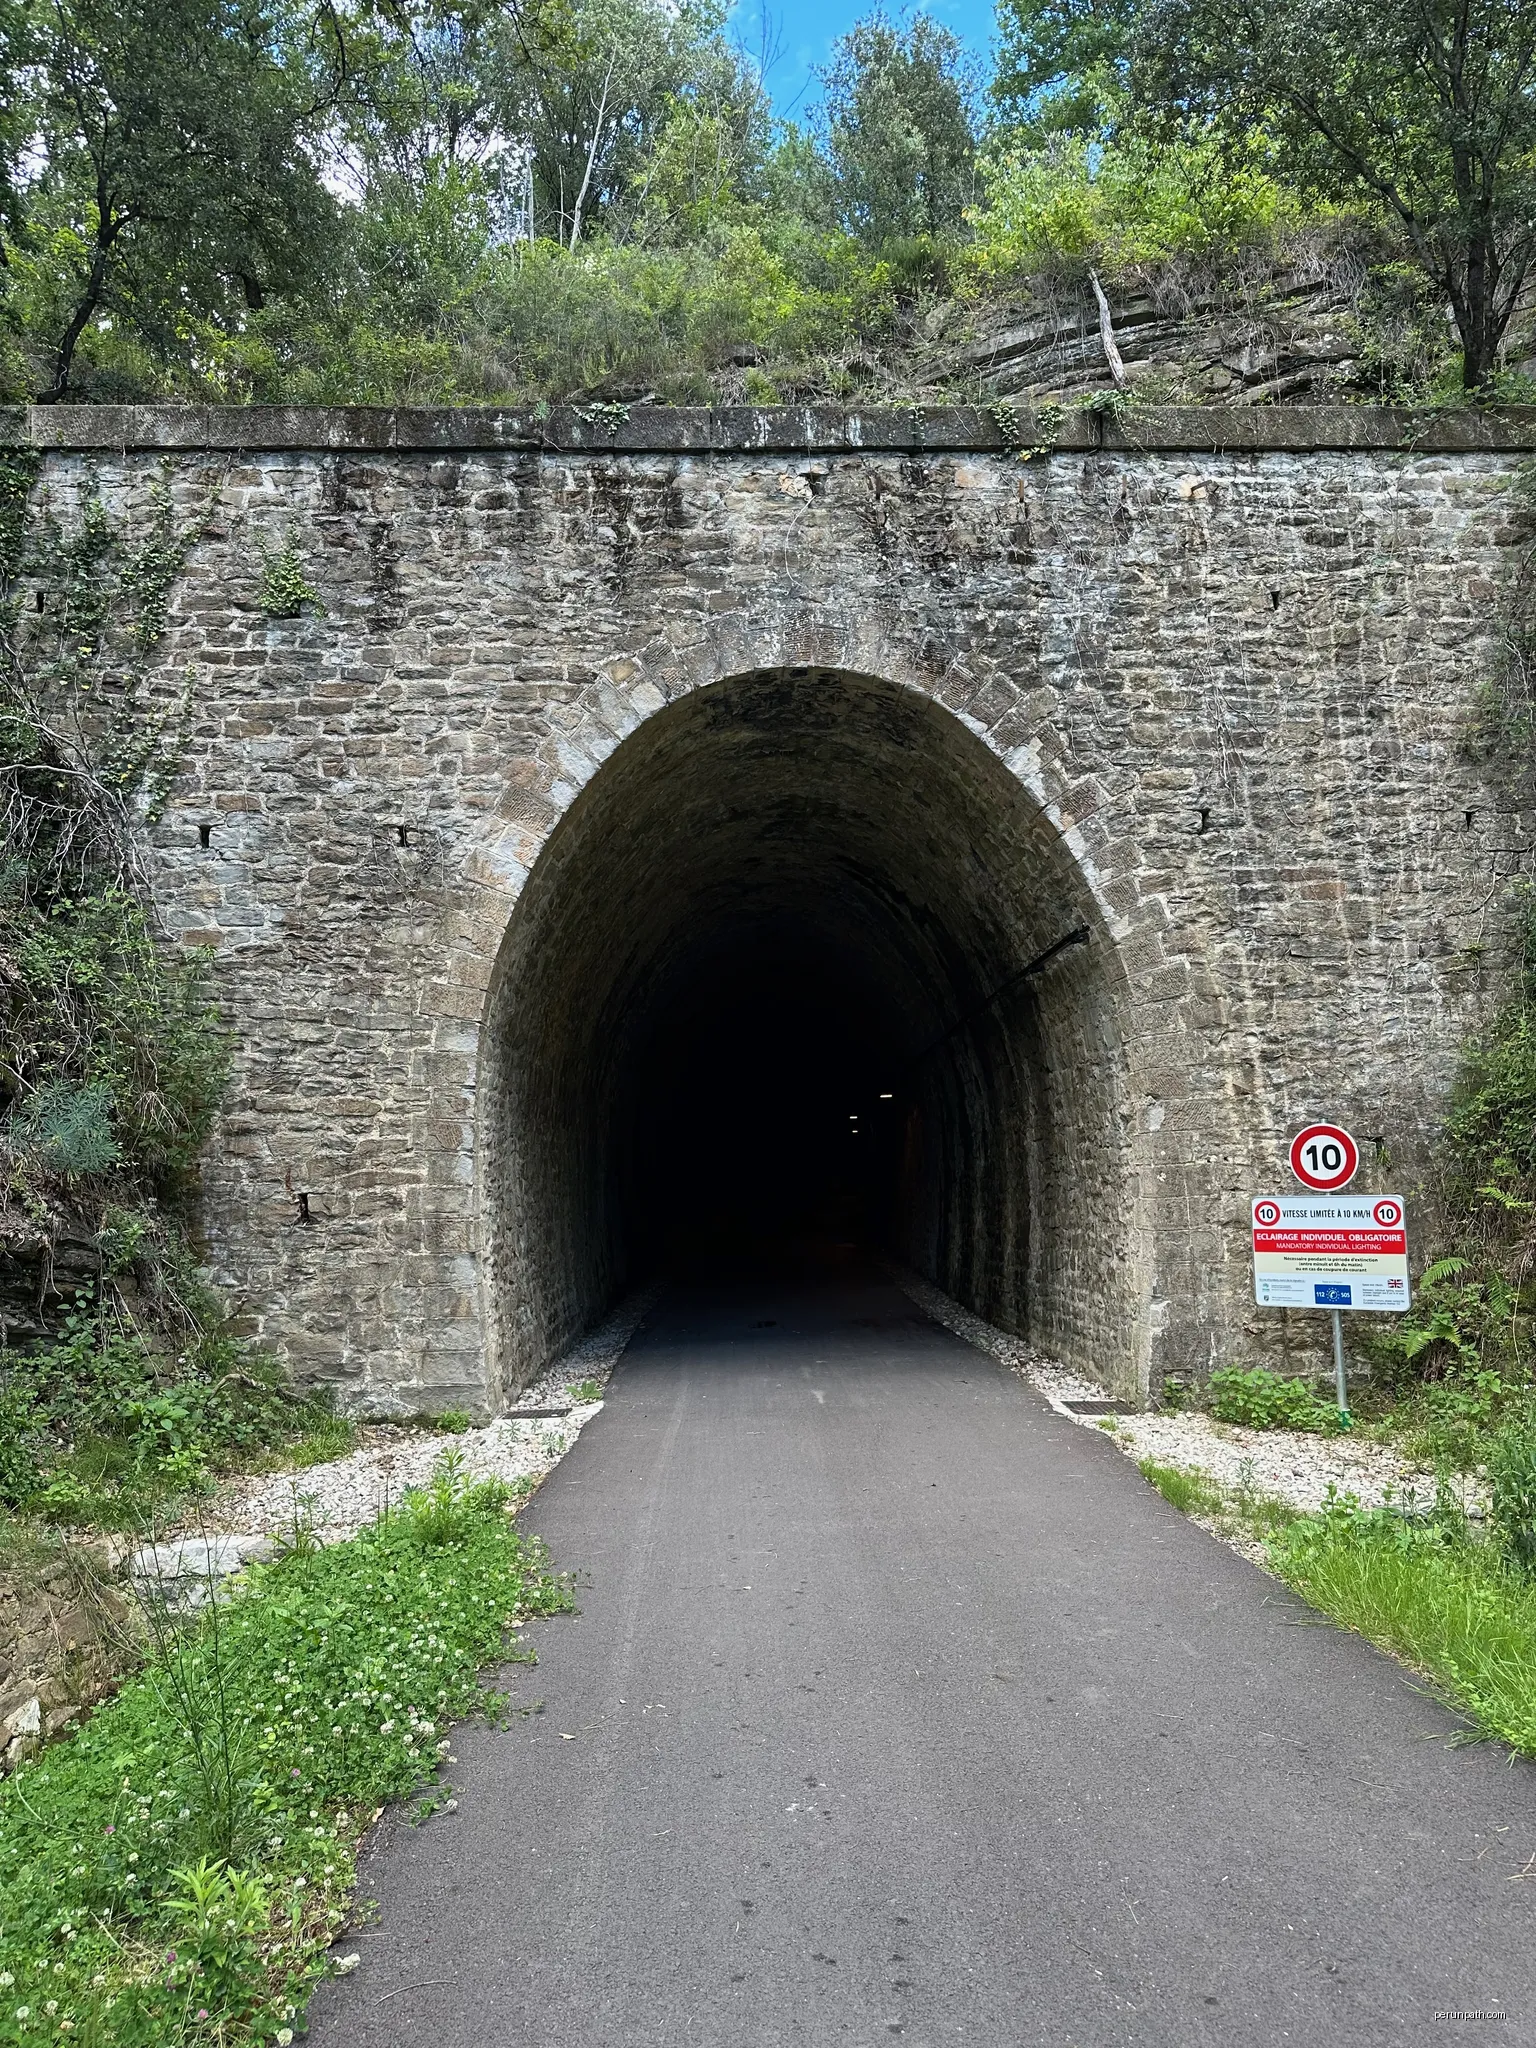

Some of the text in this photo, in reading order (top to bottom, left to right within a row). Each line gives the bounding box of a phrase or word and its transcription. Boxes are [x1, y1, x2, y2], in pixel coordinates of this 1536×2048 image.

[1306, 1144, 1341, 1171] 10
[1260, 1208, 1274, 1219] 10
[1282, 1208, 1371, 1219] VITESSE LIMITÉE À 10 KM/H
[1379, 1208, 1394, 1220] 10
[1256, 1233, 1402, 1242] ECLAIRAGE INDIVIDUEL OBLIGATOIRE
